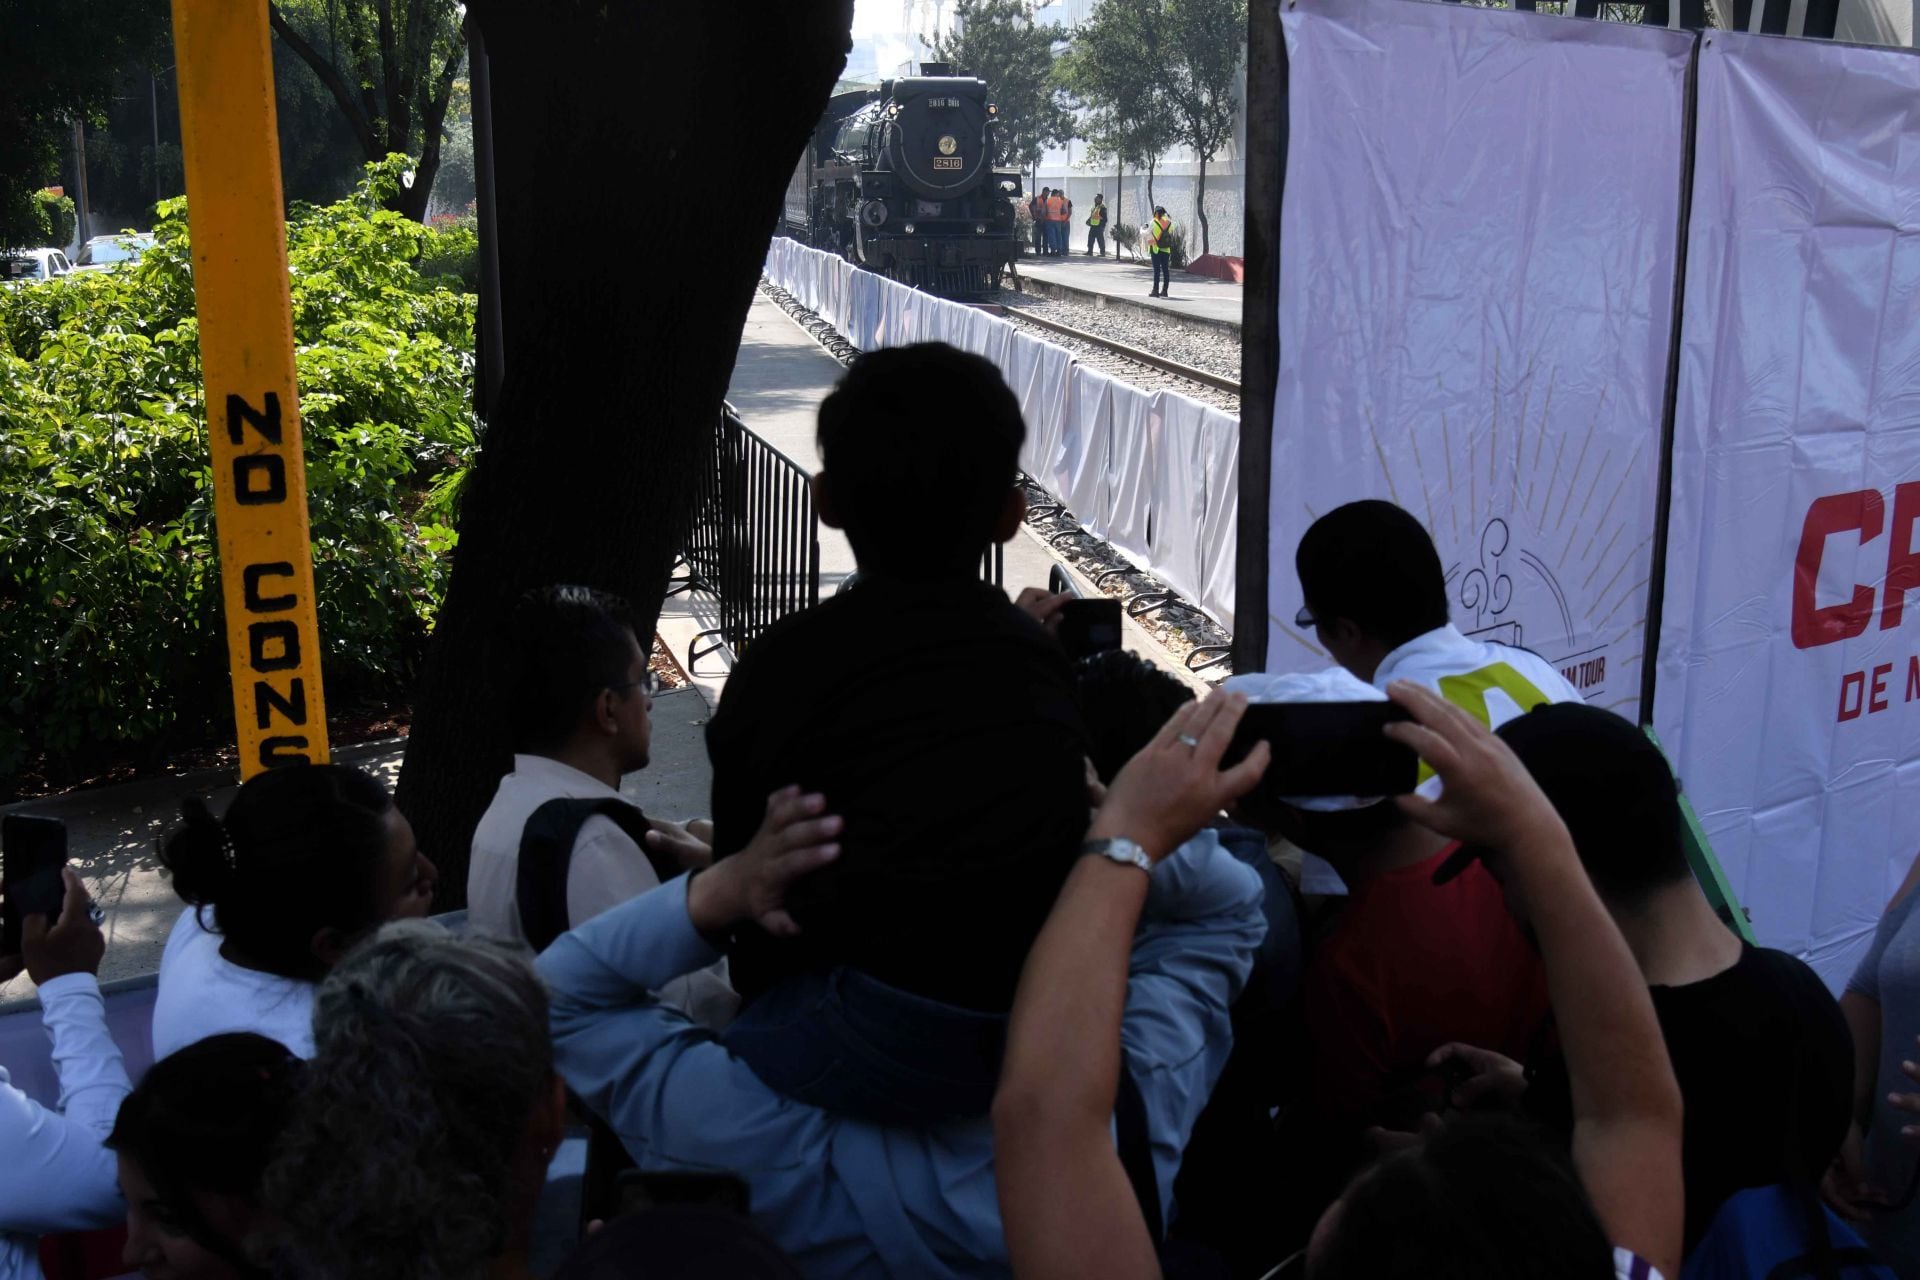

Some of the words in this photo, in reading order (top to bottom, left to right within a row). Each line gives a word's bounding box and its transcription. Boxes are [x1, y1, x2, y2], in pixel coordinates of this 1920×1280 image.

[936, 159, 960, 168] 2816
[226, 392, 287, 505] NO
[1579, 656, 1606, 689] TOUR
[1837, 662, 1893, 722] DE
